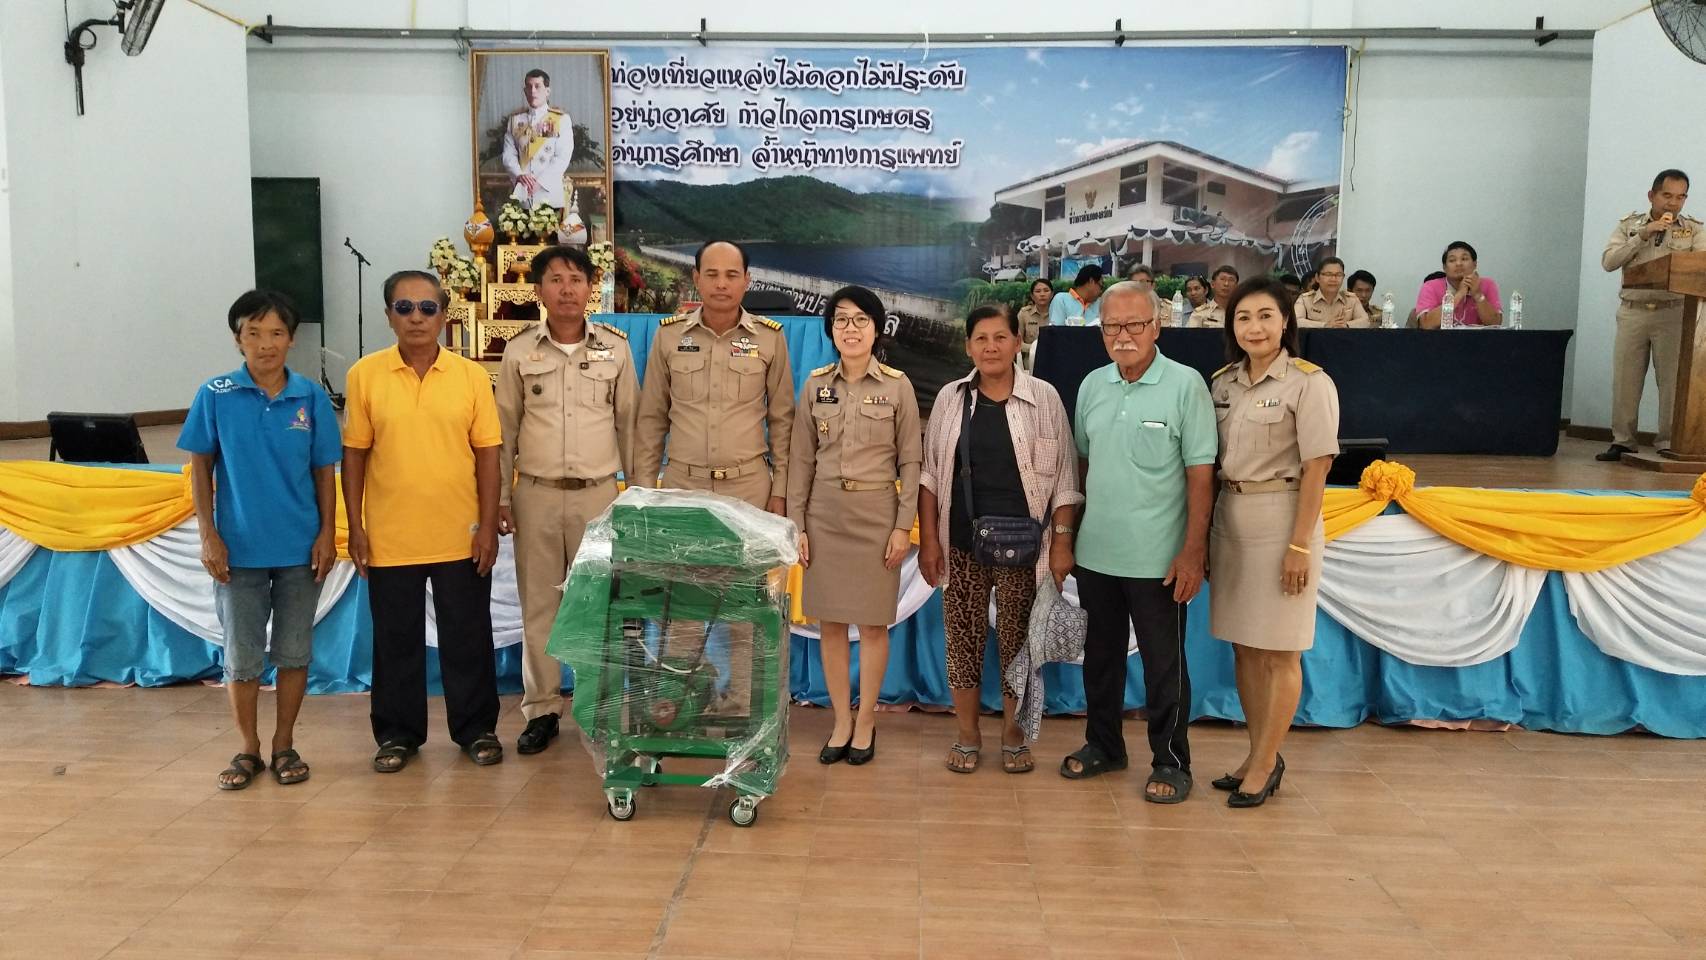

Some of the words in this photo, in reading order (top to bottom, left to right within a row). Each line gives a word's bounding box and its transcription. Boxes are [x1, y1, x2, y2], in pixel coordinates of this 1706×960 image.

[738, 97, 932, 131] ก้าวไกลการเกษตร
[751, 135, 962, 170] ล้ำหน้าทางการแพทย์
